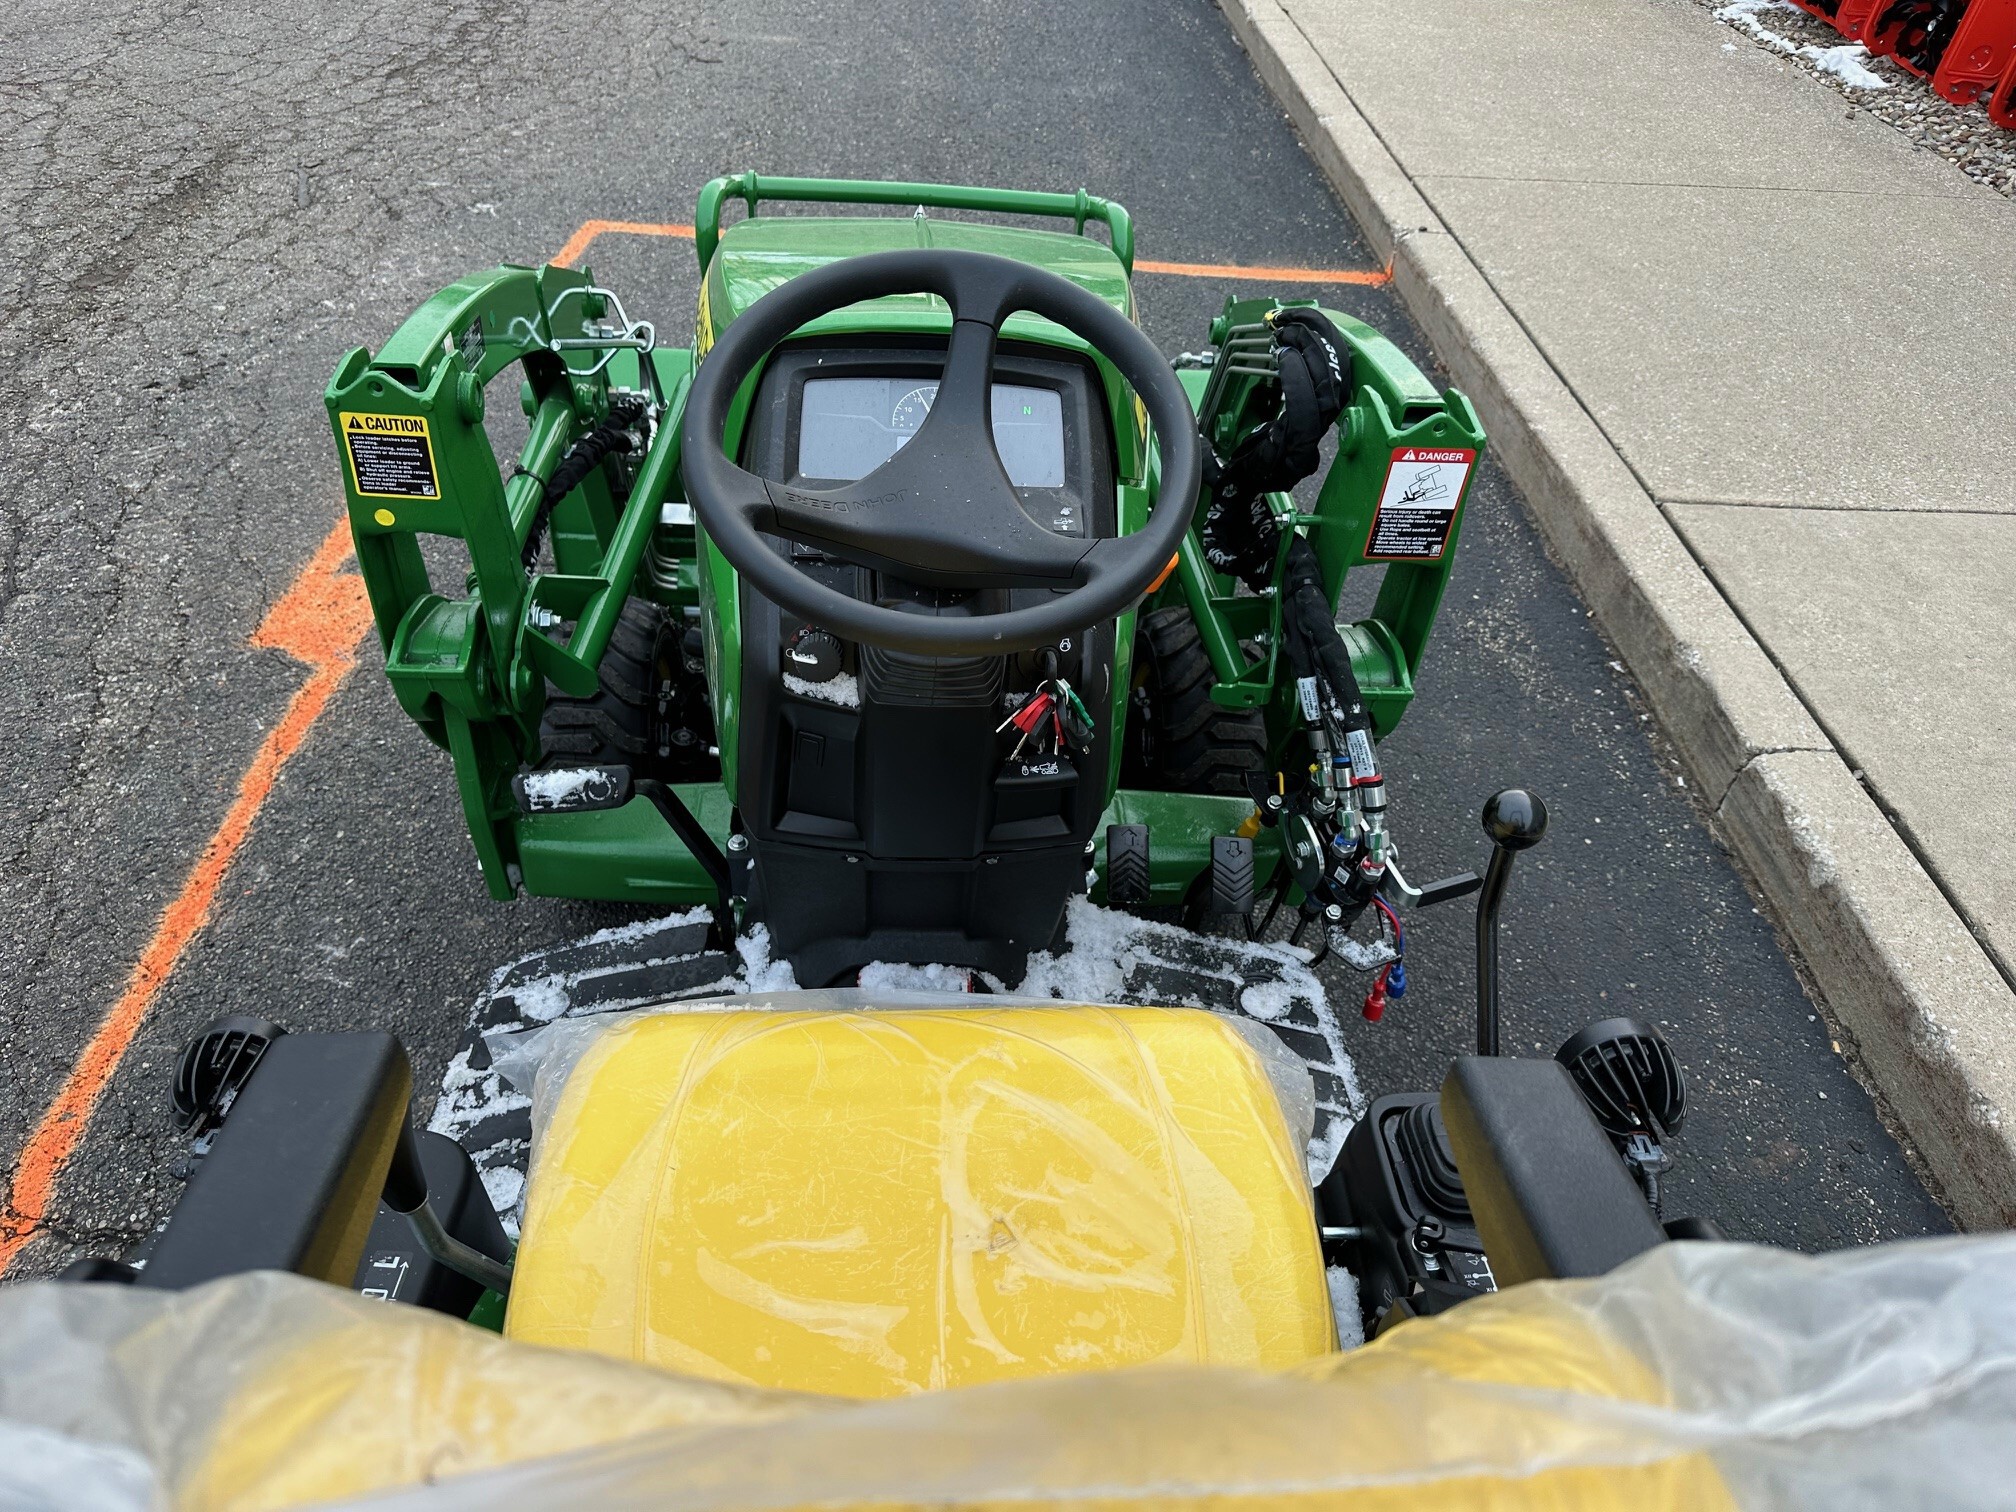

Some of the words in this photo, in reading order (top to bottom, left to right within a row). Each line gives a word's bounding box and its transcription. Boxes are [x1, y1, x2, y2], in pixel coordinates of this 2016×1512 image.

[1023, 406, 1031, 415] N
[365, 416, 424, 432] CAUTION
[1418, 452, 1464, 461] DANGER
[785, 492, 850, 514] DEERE
[853, 489, 908, 510] JOHN
